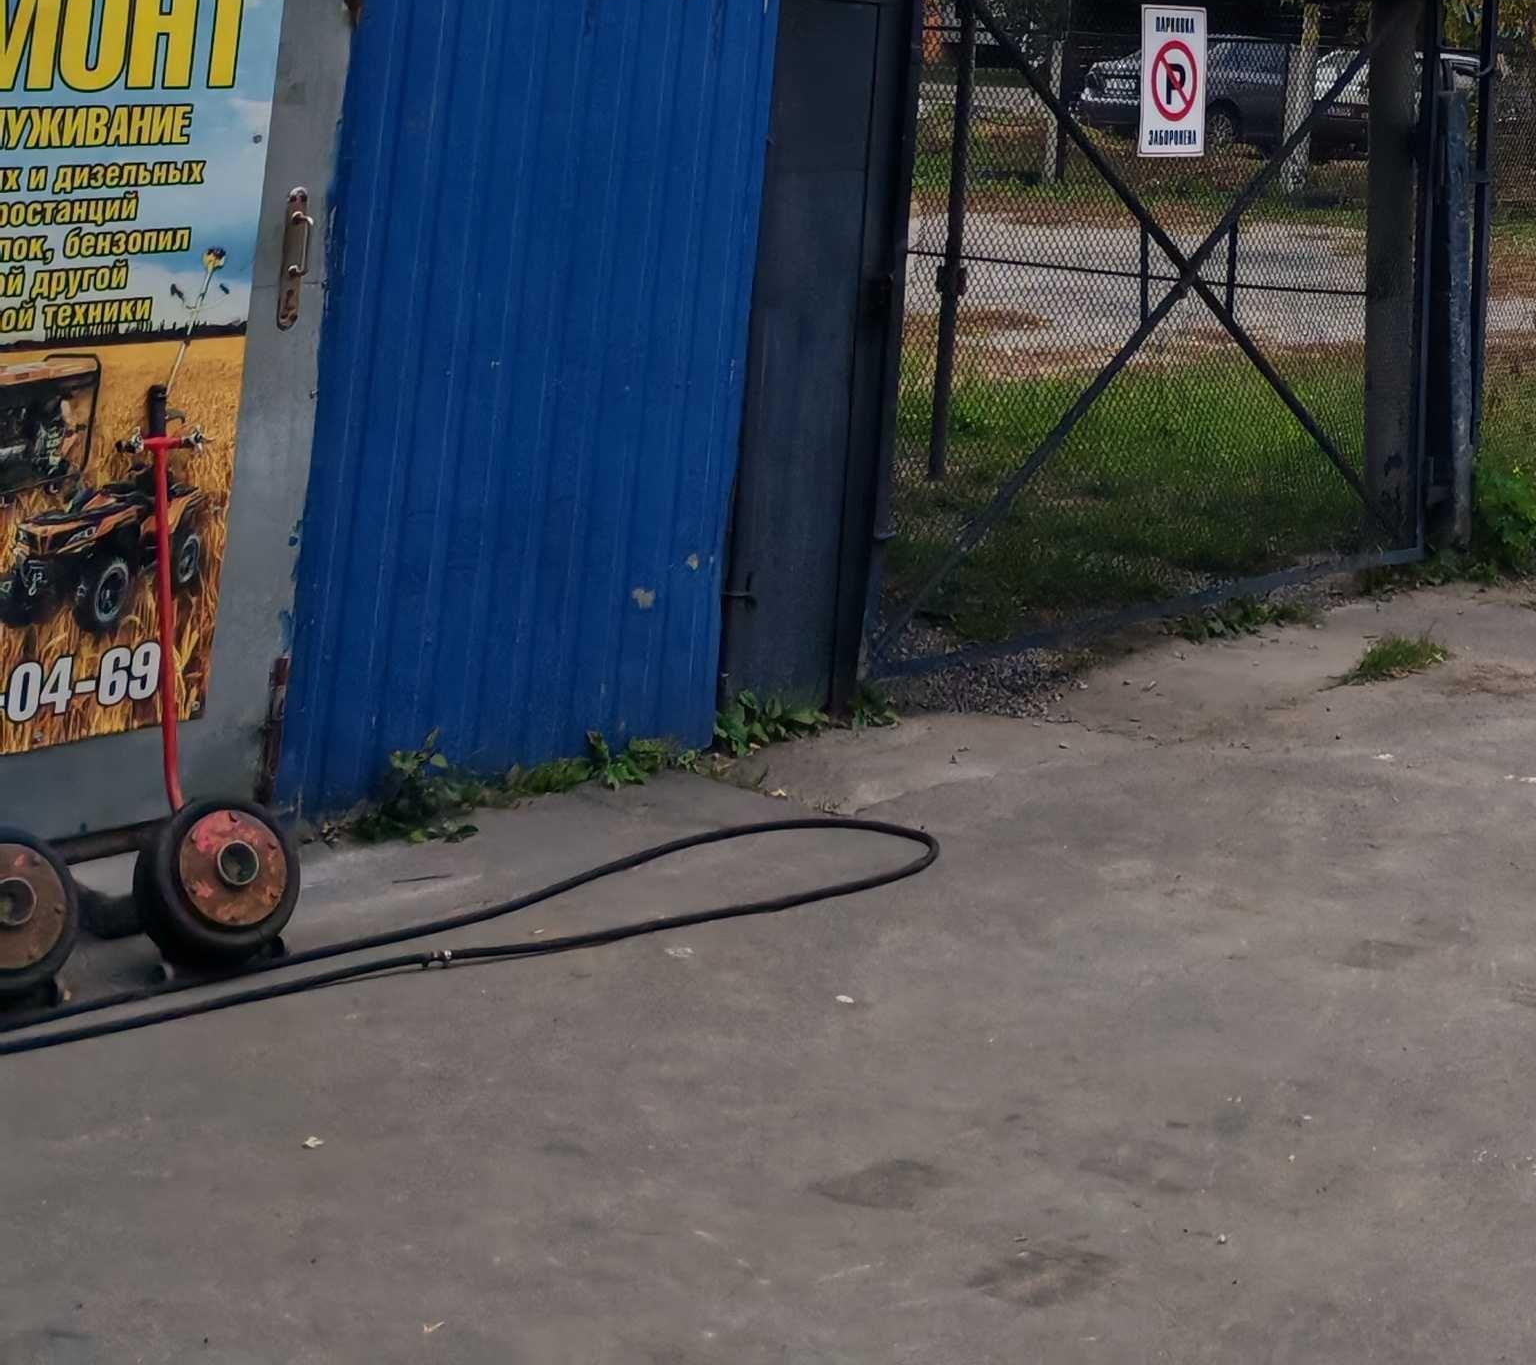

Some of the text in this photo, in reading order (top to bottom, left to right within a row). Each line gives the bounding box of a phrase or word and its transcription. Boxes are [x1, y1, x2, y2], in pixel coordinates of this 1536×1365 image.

[27, 166, 48, 192] и
[52, 160, 206, 194] дизельных
[63, 227, 192, 259] бензопил
[30, 260, 129, 301] другой
[43, 297, 153, 329] техники
